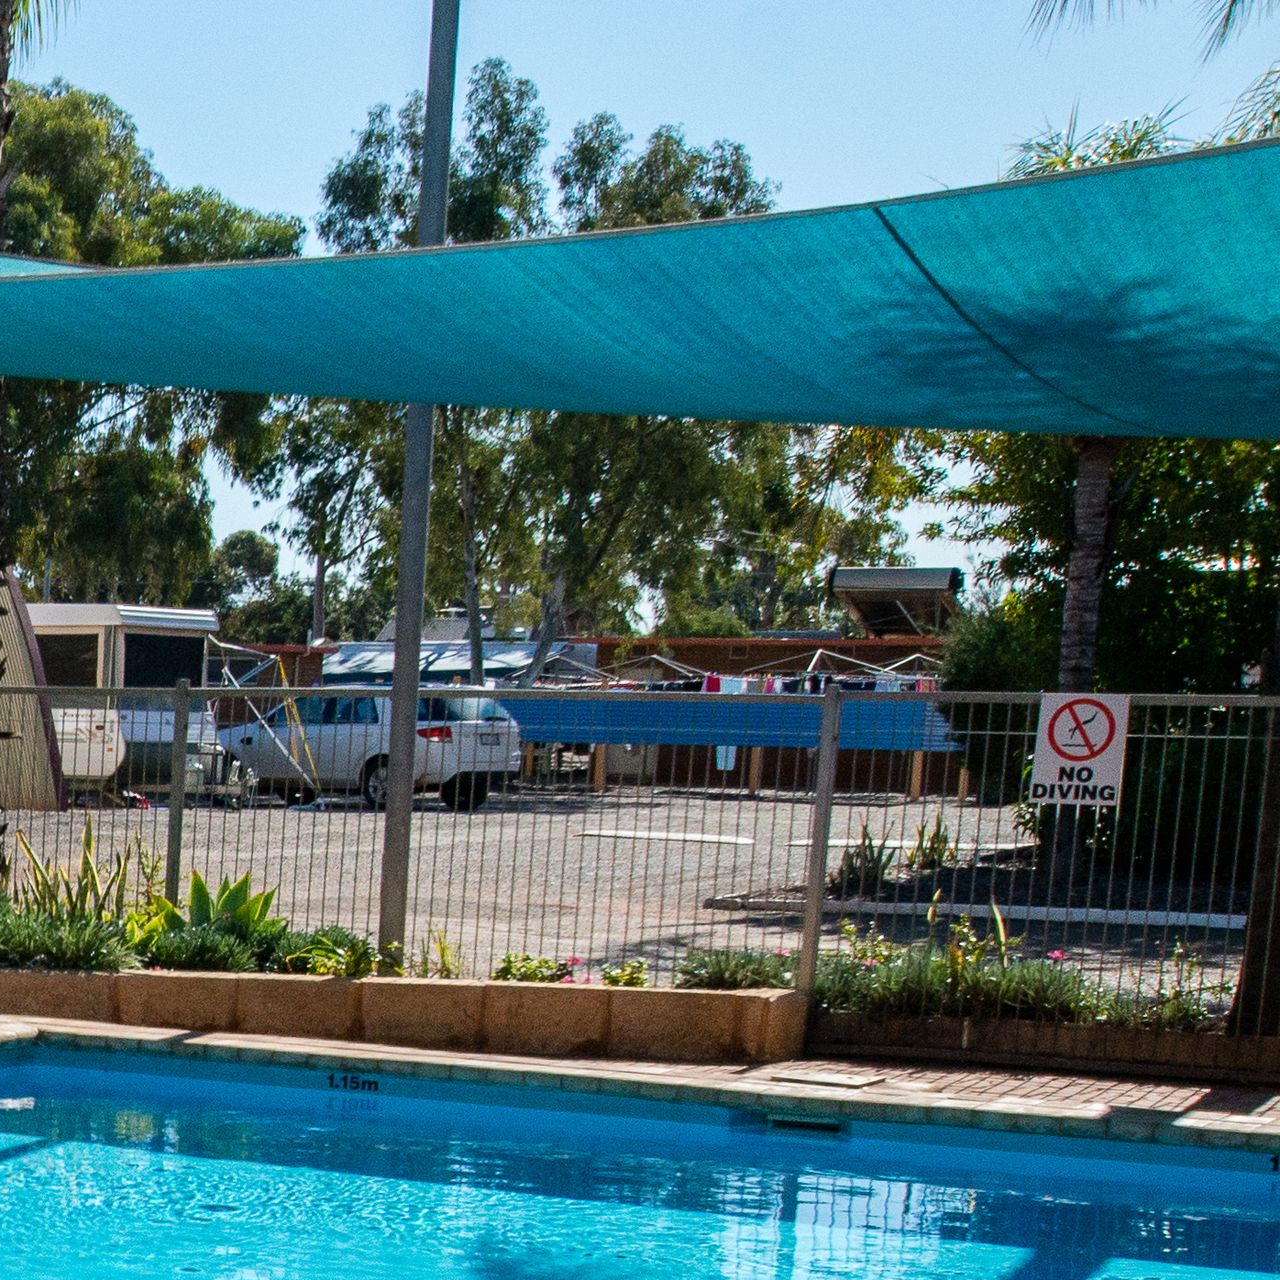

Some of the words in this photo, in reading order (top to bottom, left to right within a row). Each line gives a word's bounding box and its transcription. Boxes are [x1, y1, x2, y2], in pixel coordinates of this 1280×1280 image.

[1058, 767, 1093, 782] NO
[1032, 784, 1115, 801] DIVING
[327, 1074, 379, 1091] 1.15m
